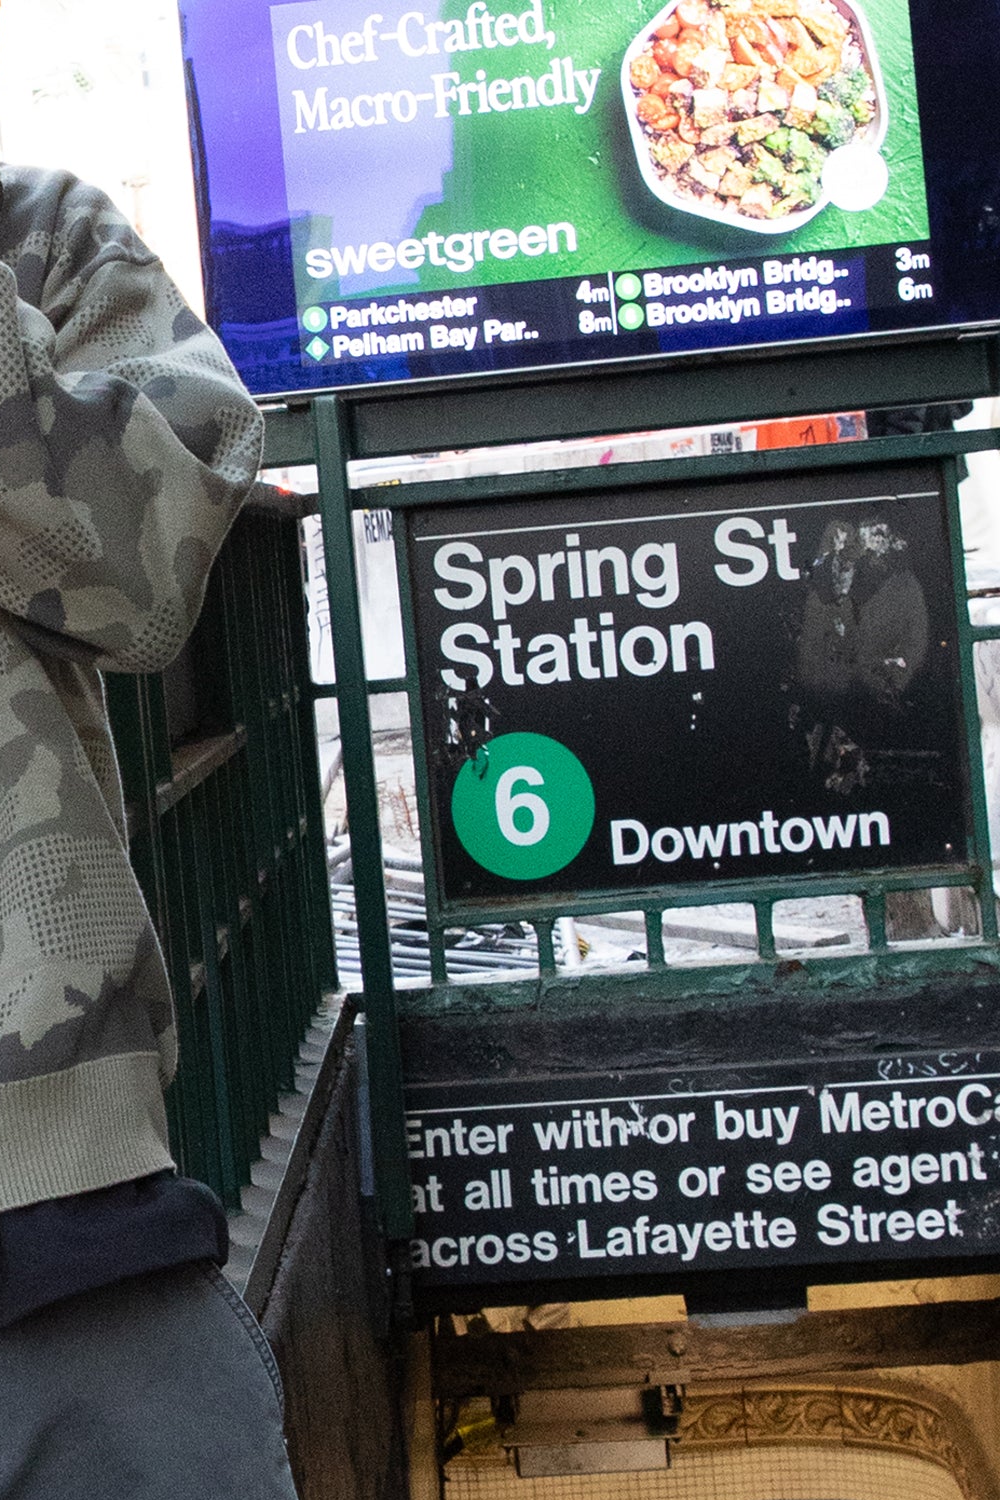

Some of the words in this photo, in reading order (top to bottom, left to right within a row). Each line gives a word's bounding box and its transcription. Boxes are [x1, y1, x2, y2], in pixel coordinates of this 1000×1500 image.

[286, 0, 555, 69] Chef-Crafted,
[292, 56, 601, 133] Macro-Friendly
[305, 221, 577, 279] sweetgreen
[643, 267, 758, 298] Brooklyn
[895, 247, 930, 272] 3m
[329, 296, 478, 329] Parkchester
[576, 280, 610, 303] 4m
[332, 332, 424, 358] Pelham
[429, 325, 478, 351] Bay
[578, 310, 613, 334] 8m
[646, 295, 760, 327] Brooklyn
[897, 277, 933, 301] 6m
[433, 533, 679, 620] Spring
[713, 518, 800, 587] St
[440, 612, 715, 692] Station
[494, 766, 550, 846] 6
[610, 810, 889, 865] Downtown
[406, 1118, 514, 1159] Enter
[532, 1107, 629, 1151] with
[648, 1110, 696, 1145] or
[714, 1100, 800, 1146] buy
[464, 1168, 512, 1211] all
[531, 1166, 658, 1206] times
[678, 1165, 726, 1198] or
[746, 1159, 832, 1195] see
[852, 1142, 987, 1196] agent
[408, 1229, 558, 1268] across
[577, 1210, 797, 1262] Lafayette
[817, 1199, 964, 1247] Street
